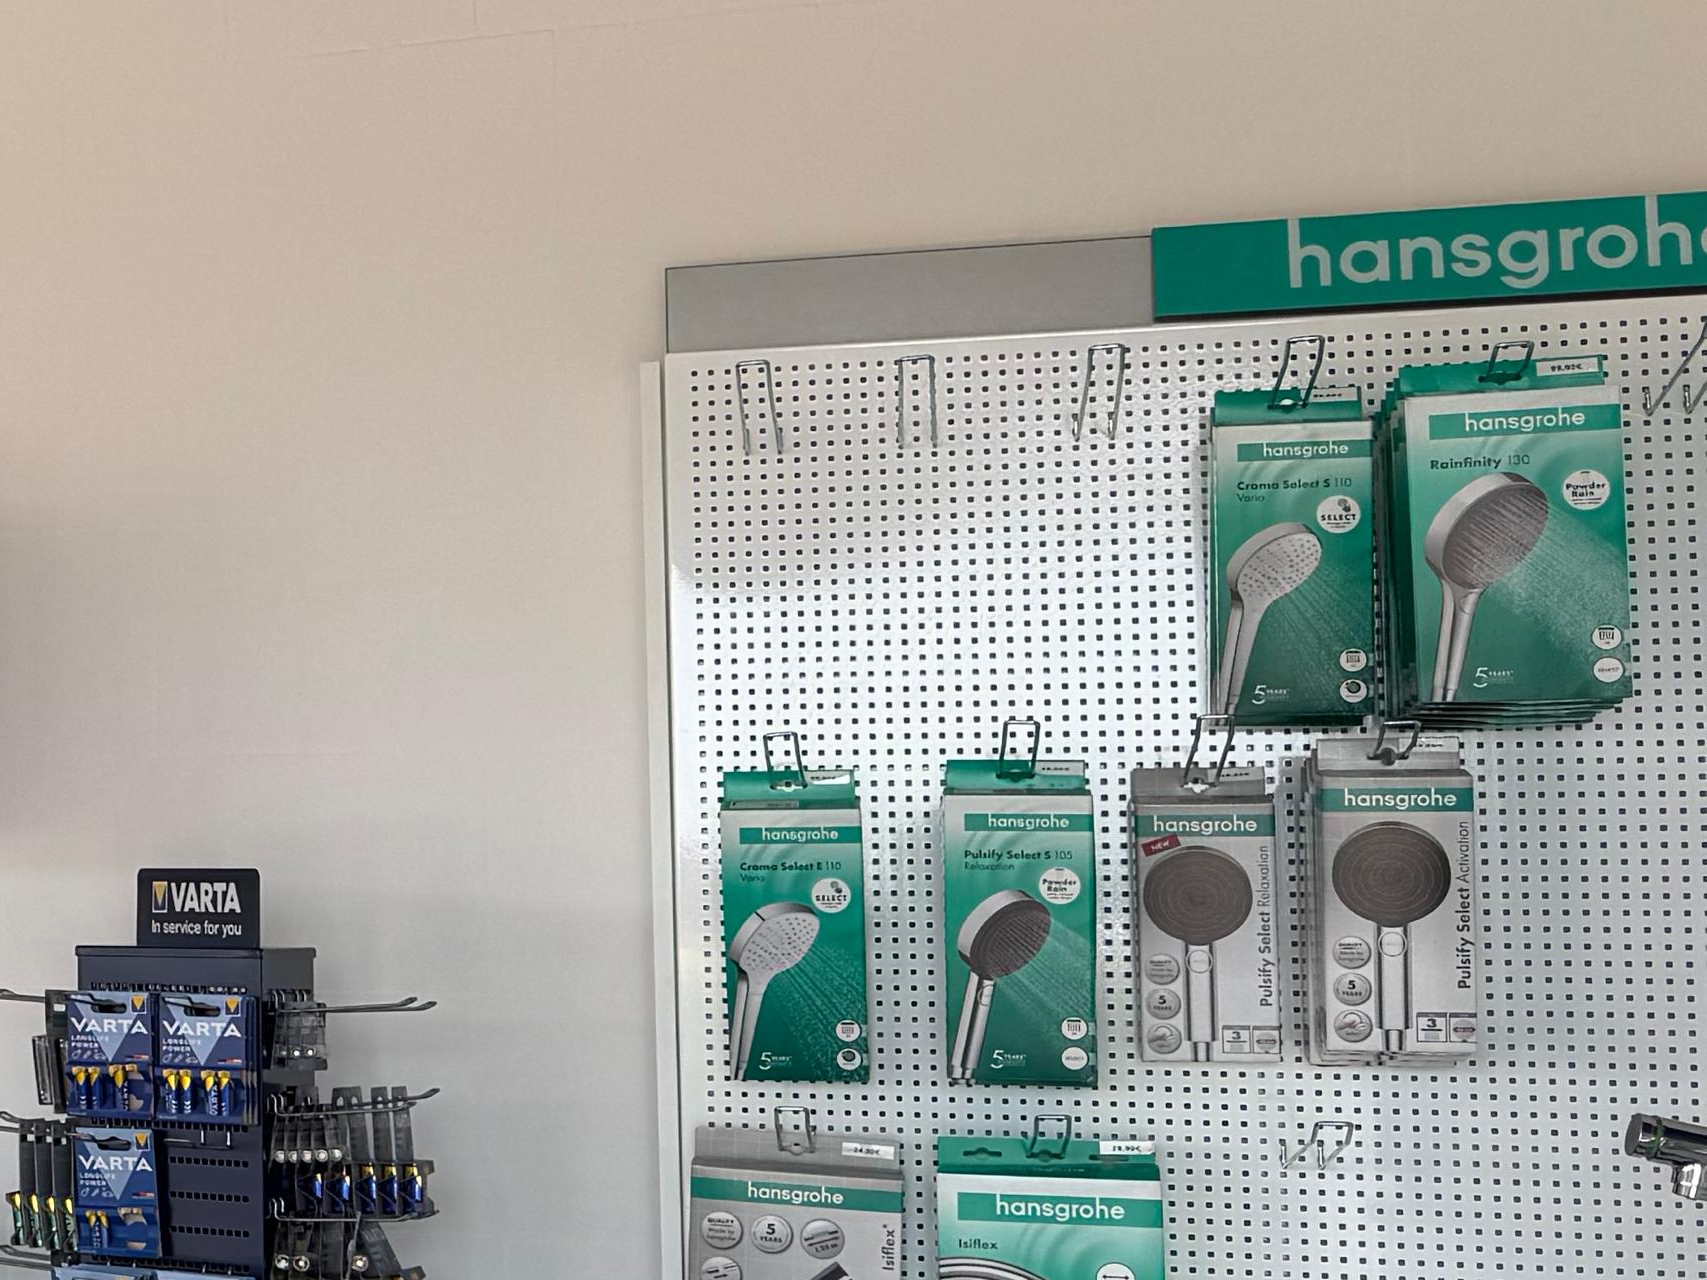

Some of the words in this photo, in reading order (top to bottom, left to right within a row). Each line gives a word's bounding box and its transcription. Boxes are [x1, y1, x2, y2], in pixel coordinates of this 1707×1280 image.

[1288, 194, 1707, 289] hansgroh
[1465, 408, 1585, 431] hansgrohe
[1263, 442, 1349, 459] hansgrohe
[1430, 457, 1501, 470] Rainfinity
[1508, 455, 1531, 466] 130
[1237, 481, 1279, 491] Croma
[1283, 478, 1319, 490] Select
[1321, 514, 1357, 522] SELECT
[1344, 787, 1457, 810] hansgrohe
[988, 813, 1069, 830] hansgrohe
[1153, 814, 1257, 835] hansgrohe
[762, 825, 838, 842] hansgrohe
[964, 849, 1003, 861] Pulsify
[1007, 850, 1041, 860] Select
[1456, 821, 1470, 882] Activation
[740, 862, 777, 871] Croma
[781, 861, 813, 871] Select
[1256, 846, 1270, 907] Relaxation
[171, 882, 242, 913] VARTA
[1455, 888, 1471, 933] Select
[152, 920, 160, 933] In
[163, 920, 201, 934] service
[204, 920, 219, 934] for
[222, 924, 242, 938] you
[1257, 912, 1271, 954] Select
[1456, 938, 1475, 989] Pulsify
[1258, 959, 1276, 1007] Pulsify
[1347, 980, 1356, 990] 5
[1158, 995, 1167, 1005] 5
[70, 1017, 148, 1035] VARTA
[163, 1021, 242, 1038] VARTA
[78, 1155, 153, 1172] VARTA
[748, 1181, 844, 1204] hansgrohe
[996, 1194, 1125, 1221] hansgrohe
[766, 1223, 776, 1235] 5
[959, 1238, 998, 1250] Isiflex
